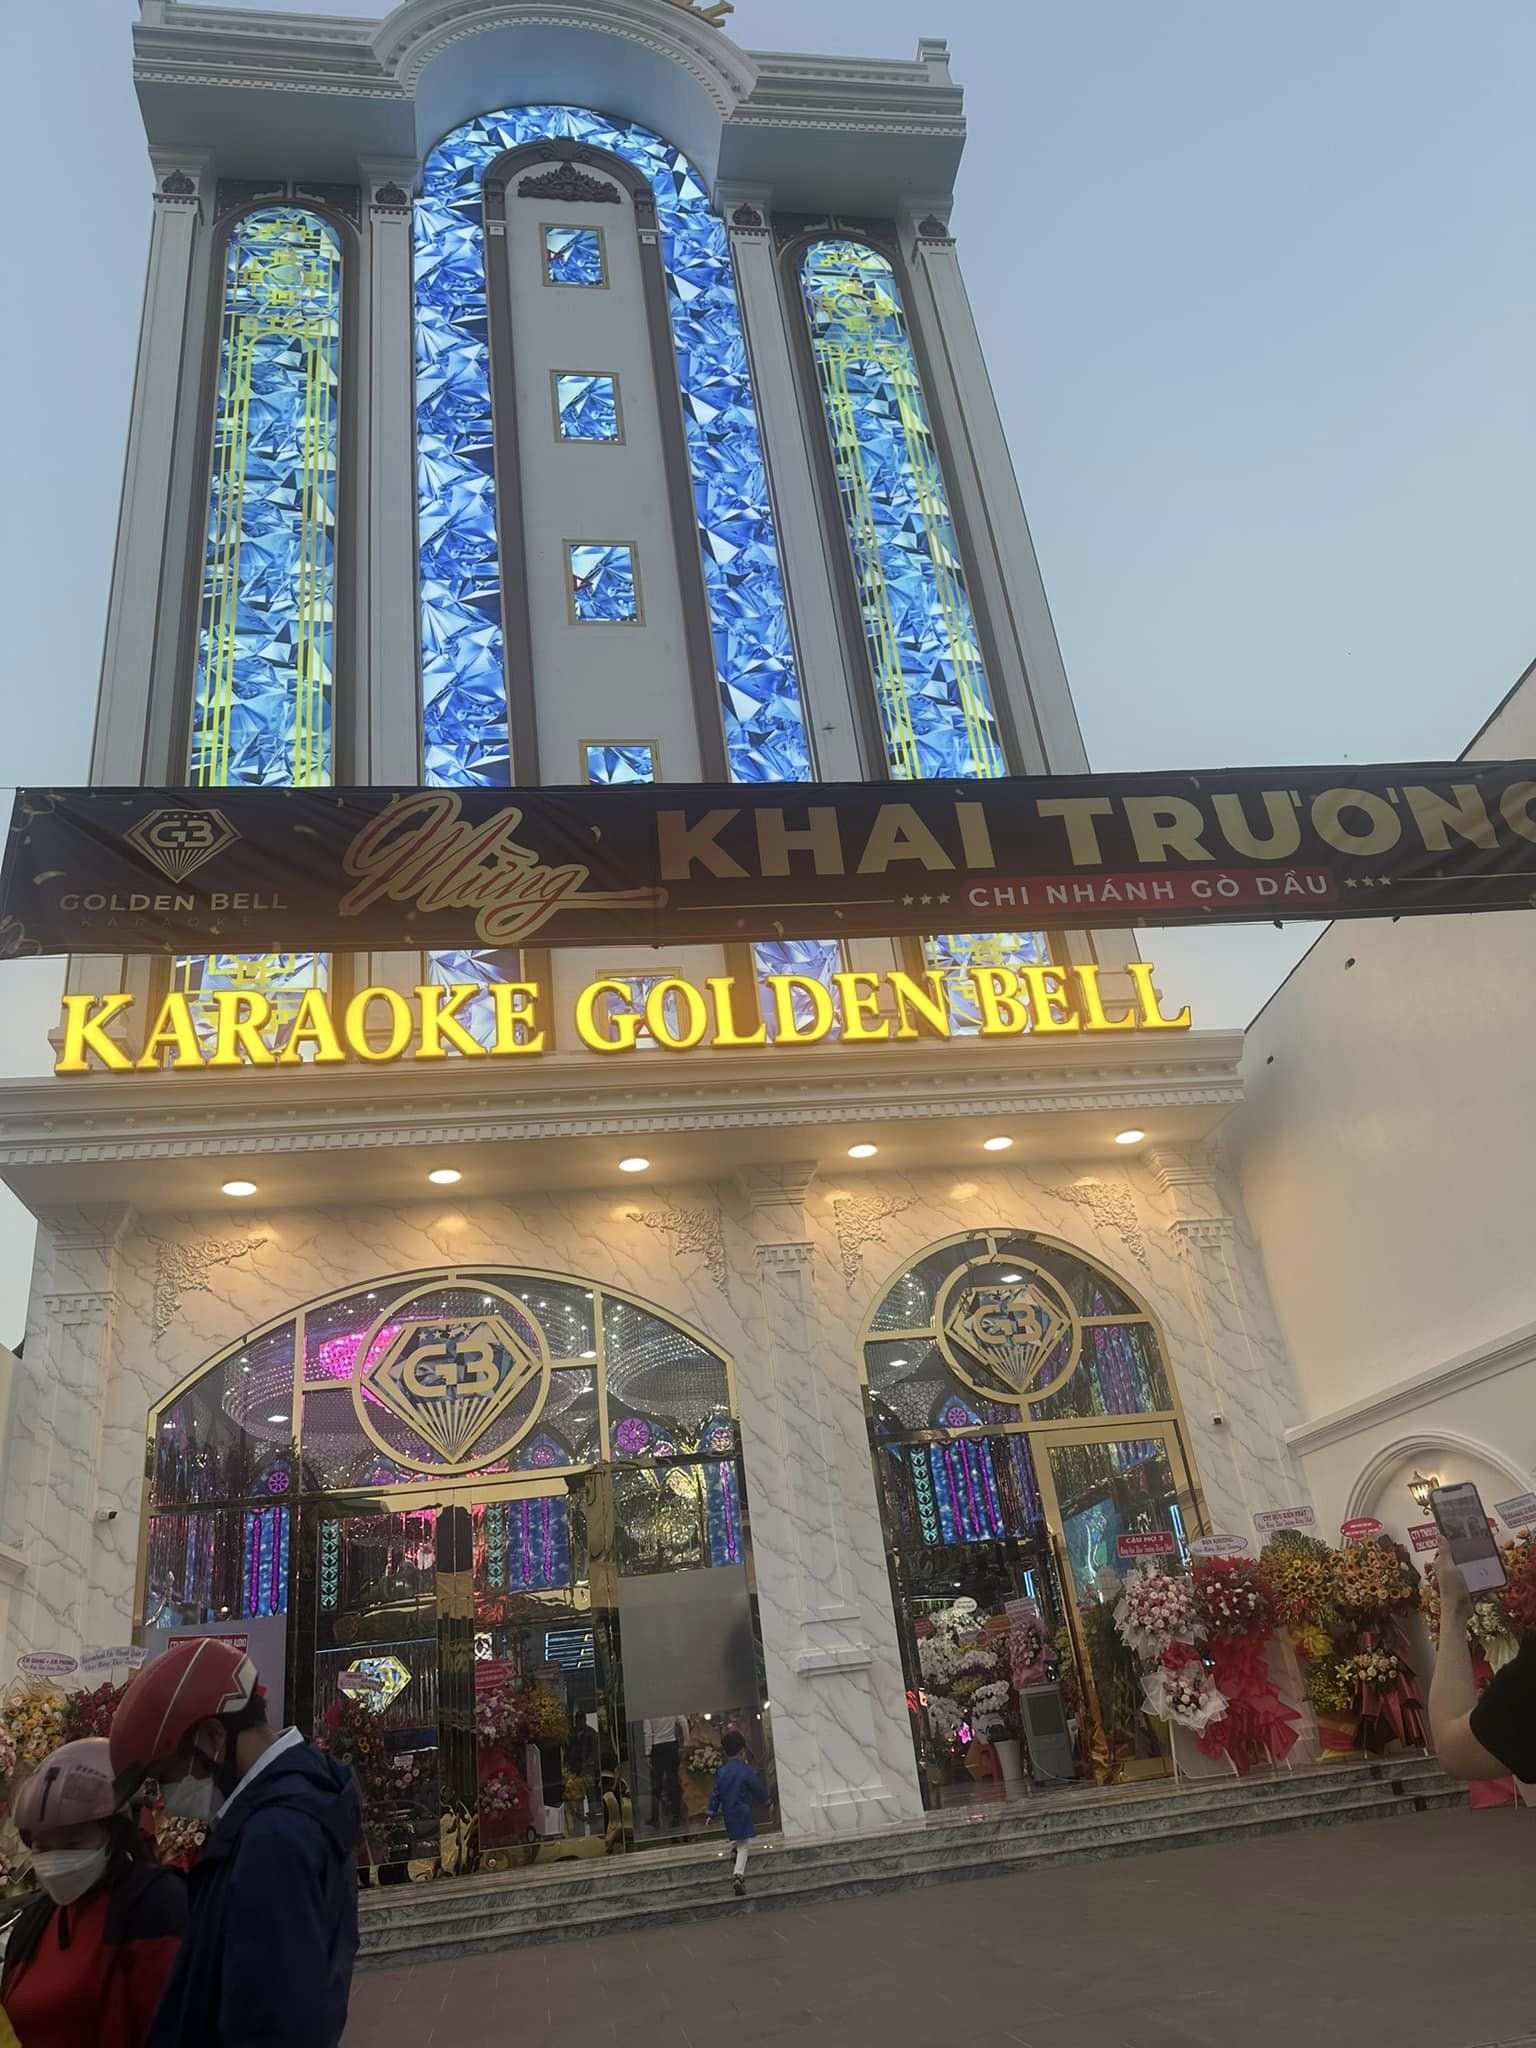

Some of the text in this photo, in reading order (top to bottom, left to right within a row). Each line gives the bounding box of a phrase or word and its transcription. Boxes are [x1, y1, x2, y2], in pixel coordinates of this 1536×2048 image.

[655, 801, 996, 880] KHAI
[59, 893, 288, 911] GOLDEN BELL
[968, 870, 1328, 907] CHI NHÁNH GÒ DẦU
[81, 916, 254, 927] KARAOKE
[54, 963, 1192, 1074] KARAOKE GOLDEN BELL
